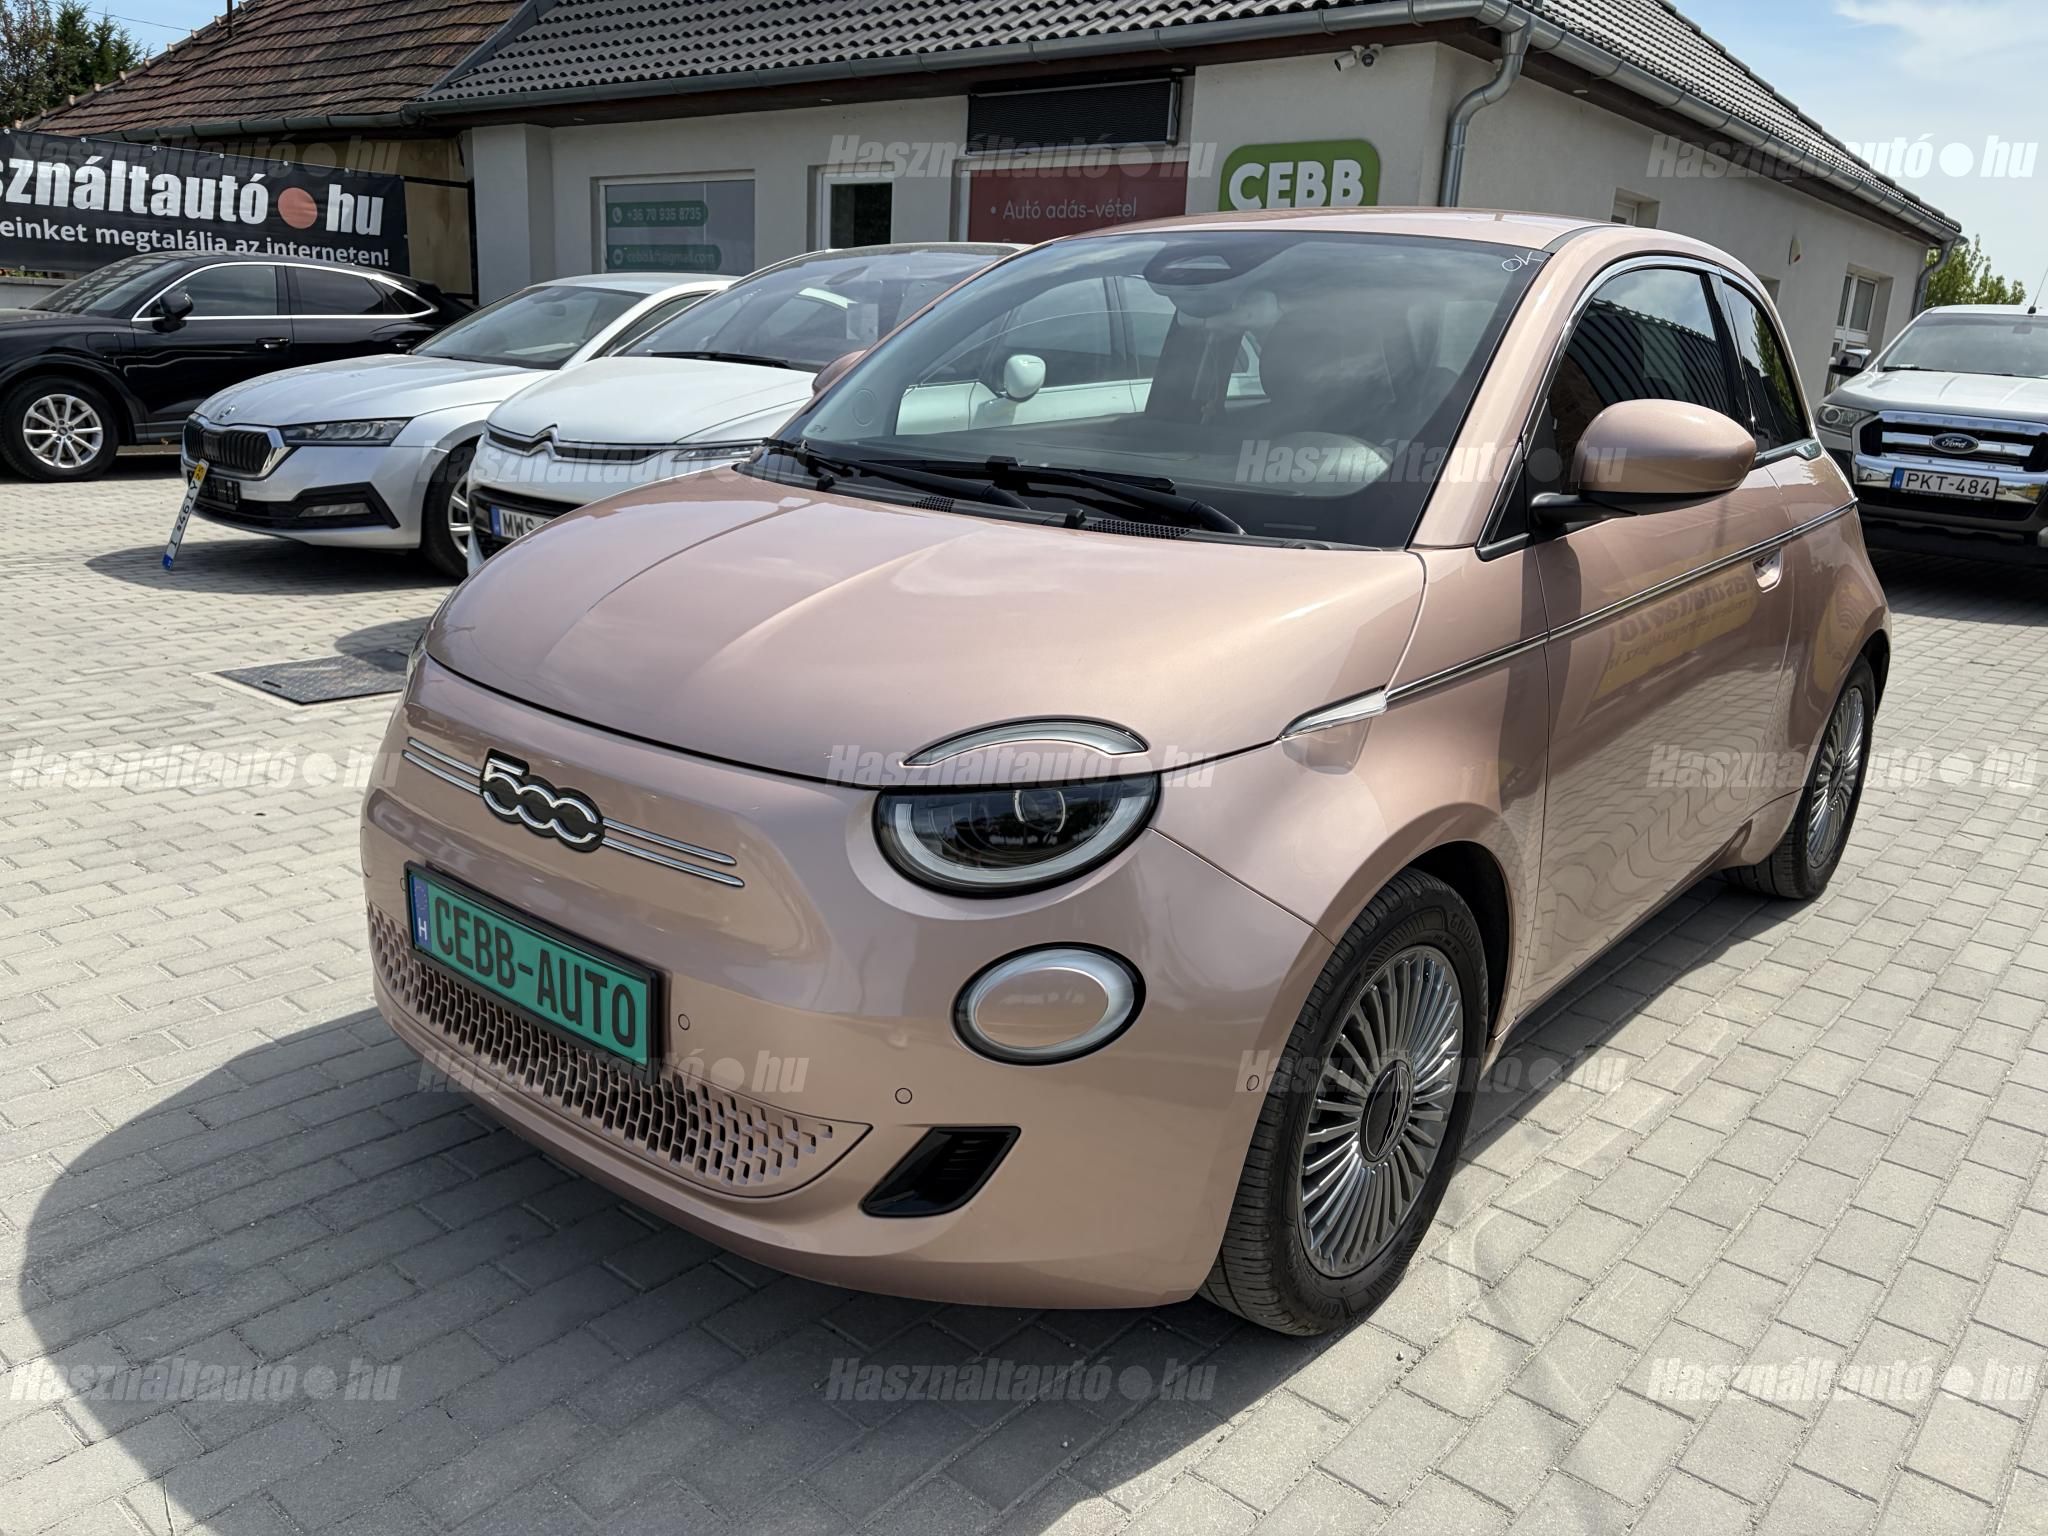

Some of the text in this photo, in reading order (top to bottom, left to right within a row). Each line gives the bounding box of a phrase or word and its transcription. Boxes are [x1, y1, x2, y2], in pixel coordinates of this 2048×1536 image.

[0, 156, 385, 237] ználtautó hu
[1003, 196, 1137, 220] Autó adás-vétel
[1229, 159, 1364, 211] CEBB
[0, 216, 87, 243] einket
[236, 238, 259, 255] az
[266, 237, 390, 267] interneten!
[1941, 438, 1968, 450] Ford
[1905, 472, 1991, 497] PKT-484
[502, 511, 549, 537] MWS
[482, 754, 602, 846] 500
[418, 896, 637, 1048] H CEBB-AUTO
